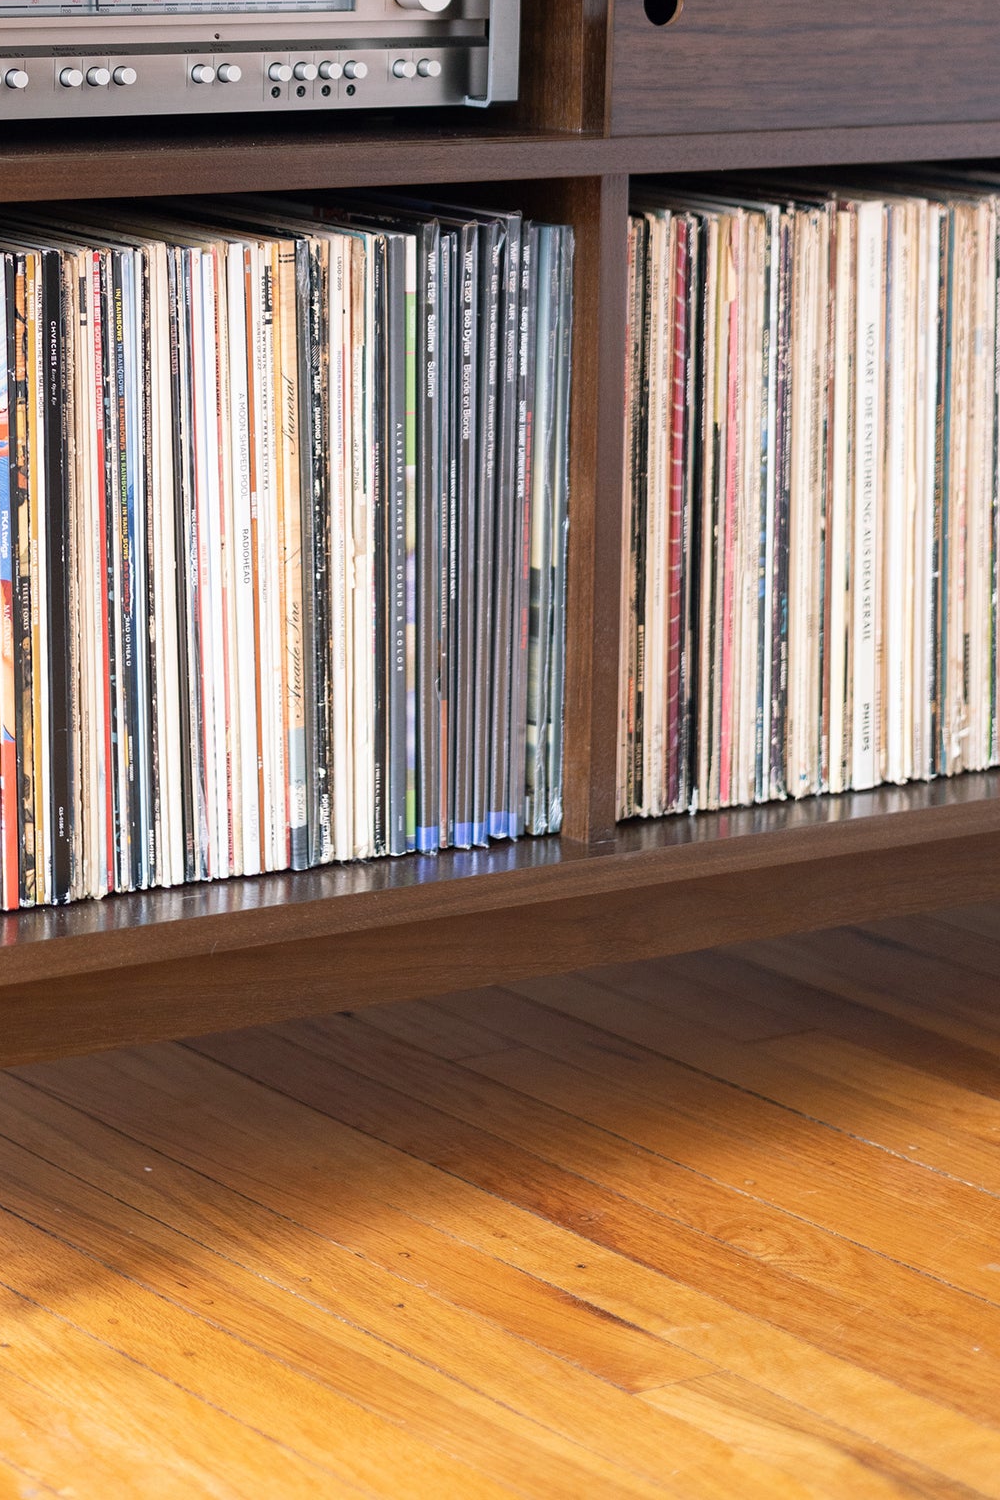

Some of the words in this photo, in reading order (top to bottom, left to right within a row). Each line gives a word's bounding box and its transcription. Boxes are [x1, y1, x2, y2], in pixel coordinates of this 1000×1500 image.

[428, 251, 436, 274] VMP
[464, 250, 472, 274] VMP
[491, 245, 499, 267] VMP
[509, 240, 517, 265] VMP
[522, 245, 530, 263] VMP
[464, 280, 472, 303] E120
[521, 270, 529, 289] E123
[427, 282, 436, 304] E124
[115, 302, 123, 341] RAINBOWS
[464, 309, 472, 329] Bob
[519, 306, 528, 332] Kacey
[427, 314, 436, 352] Sublime
[463, 330, 472, 356] Dylan
[489, 323, 497, 358] Grateful
[117, 343, 123, 352] IN
[519, 334, 527, 376] Musgraves
[864, 323, 874, 384] MOZART
[427, 361, 436, 397] Sublime
[463, 364, 471, 396] Blonde
[506, 356, 514, 382] Safari
[96, 387, 104, 430] CUSTOMER
[118, 397, 125, 406] IN
[463, 397, 470, 408] on
[487, 395, 496, 429] Anthem
[518, 400, 526, 423] Same
[864, 396, 873, 421] DIE
[238, 402, 246, 430] MOON
[462, 409, 471, 439] Blonde
[487, 431, 495, 441] Of
[518, 424, 526, 446] Trailer
[120, 452, 127, 460] IN
[240, 434, 248, 471] SHAPED
[517, 448, 526, 480] Different
[240, 474, 249, 499] POOL
[1, 510, 9, 530] FKA
[121, 506, 128, 515] IN
[0, 531, 9, 558] twigs
[862, 528, 871, 557] AUS
[242, 529, 250, 584] RADIOHEAD
[862, 560, 871, 592] DEM
[3, 605, 11, 656] MAGDALENE
[862, 596, 871, 644] SERAIL
[861, 702, 870, 752] PHILIPS
